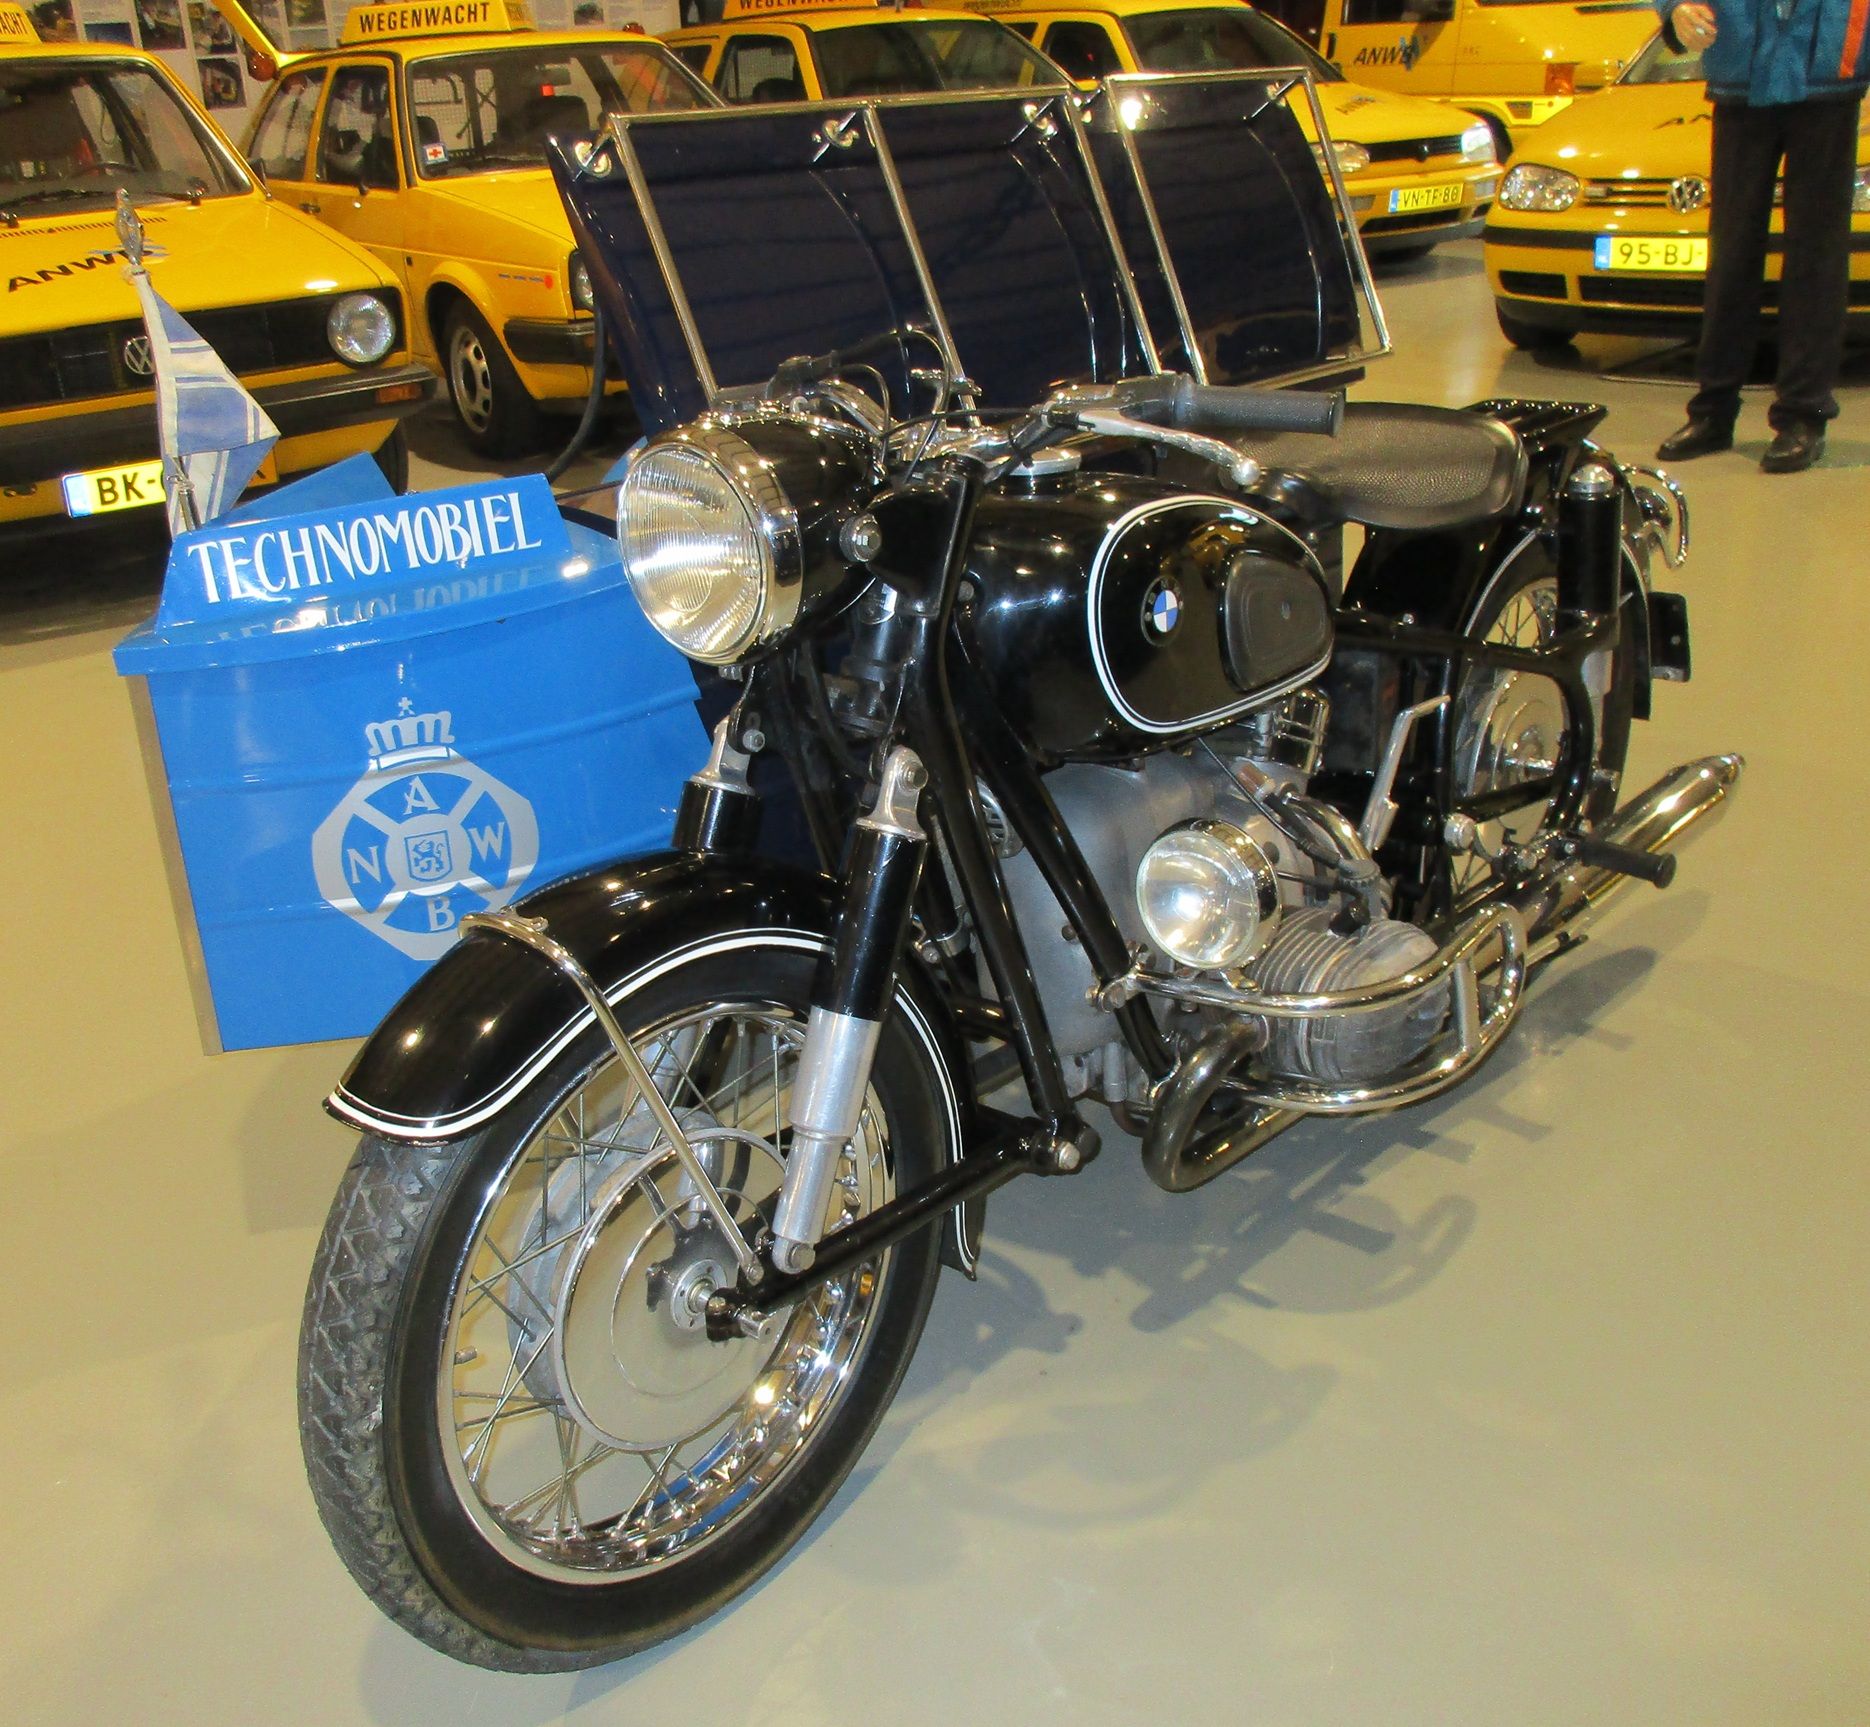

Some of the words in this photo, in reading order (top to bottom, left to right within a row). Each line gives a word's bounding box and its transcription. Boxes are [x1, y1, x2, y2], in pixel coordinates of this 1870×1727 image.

[359, 2, 490, 33] WEGENWACHT
[96, 471, 166, 507] BK-
[187, 491, 543, 604] TECHNOMOBIEL
